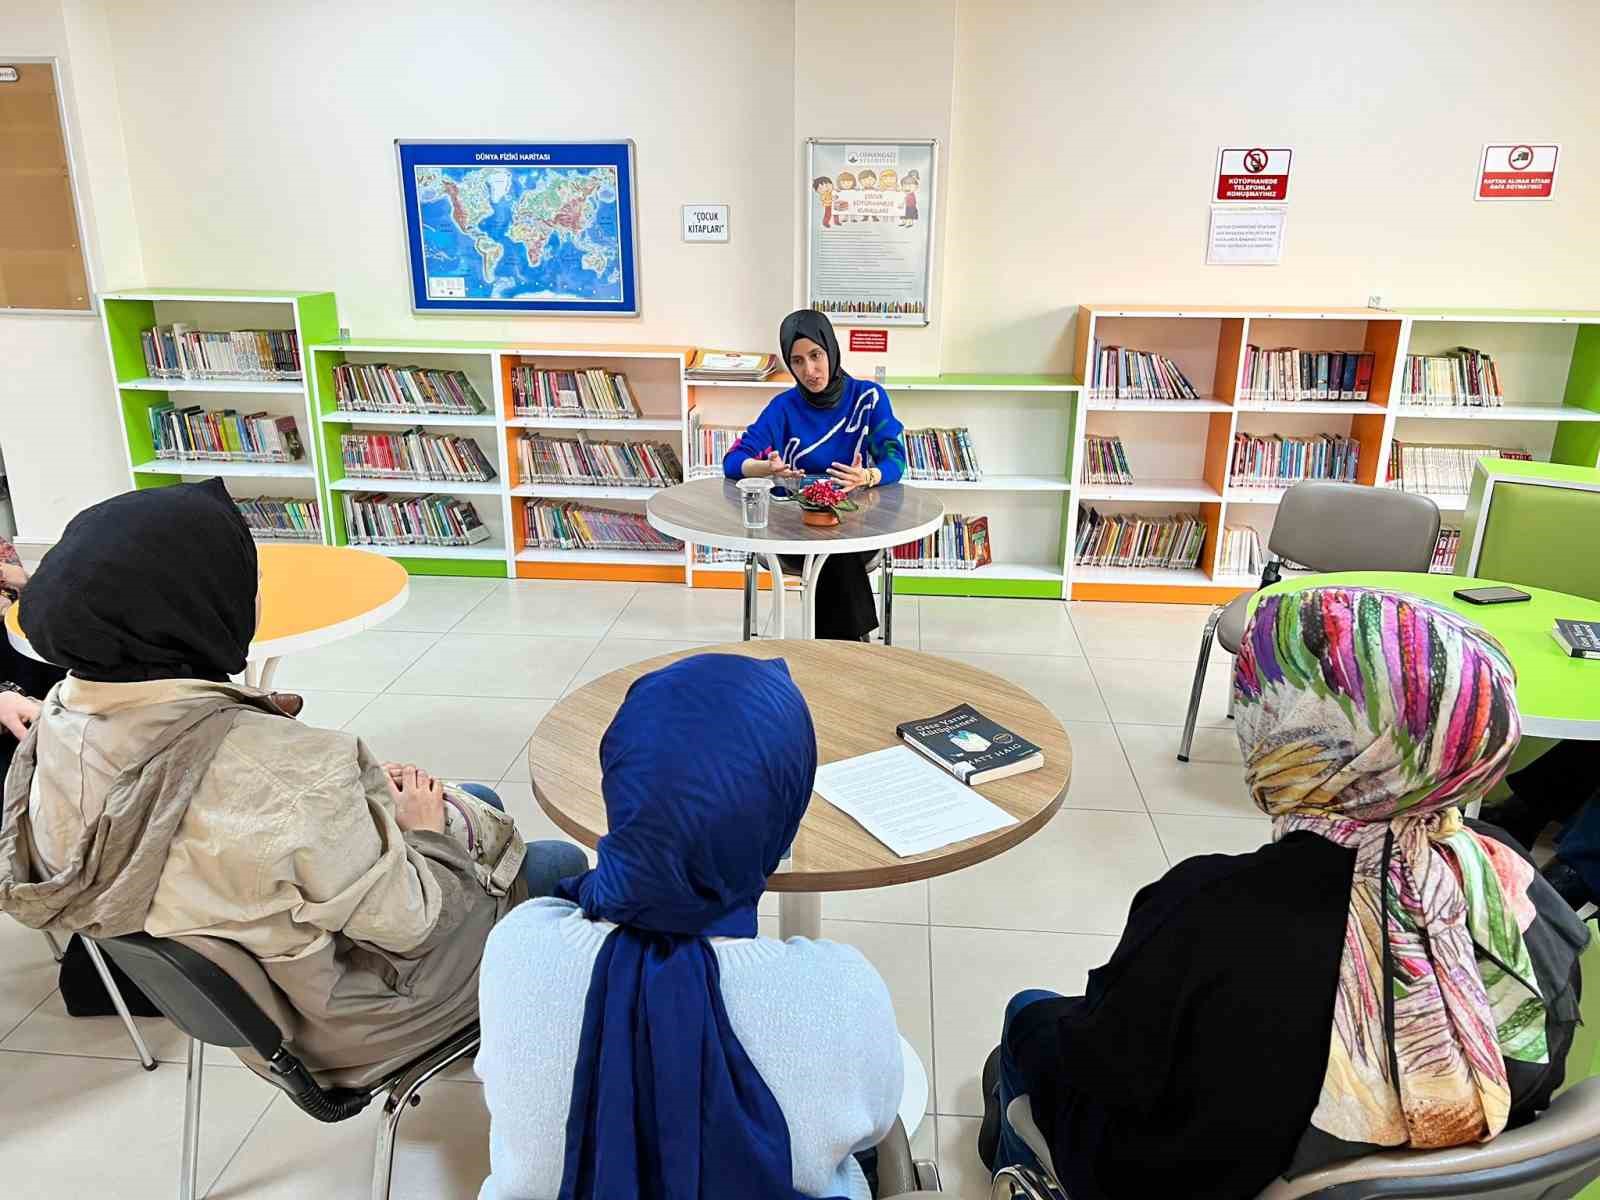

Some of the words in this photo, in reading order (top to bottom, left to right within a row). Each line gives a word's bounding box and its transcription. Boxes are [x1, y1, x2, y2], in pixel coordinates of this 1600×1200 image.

[475, 152, 499, 160] DÜNYA
[519, 152, 551, 160] HARİTASI
[994, 743, 1022, 757] HAIG
